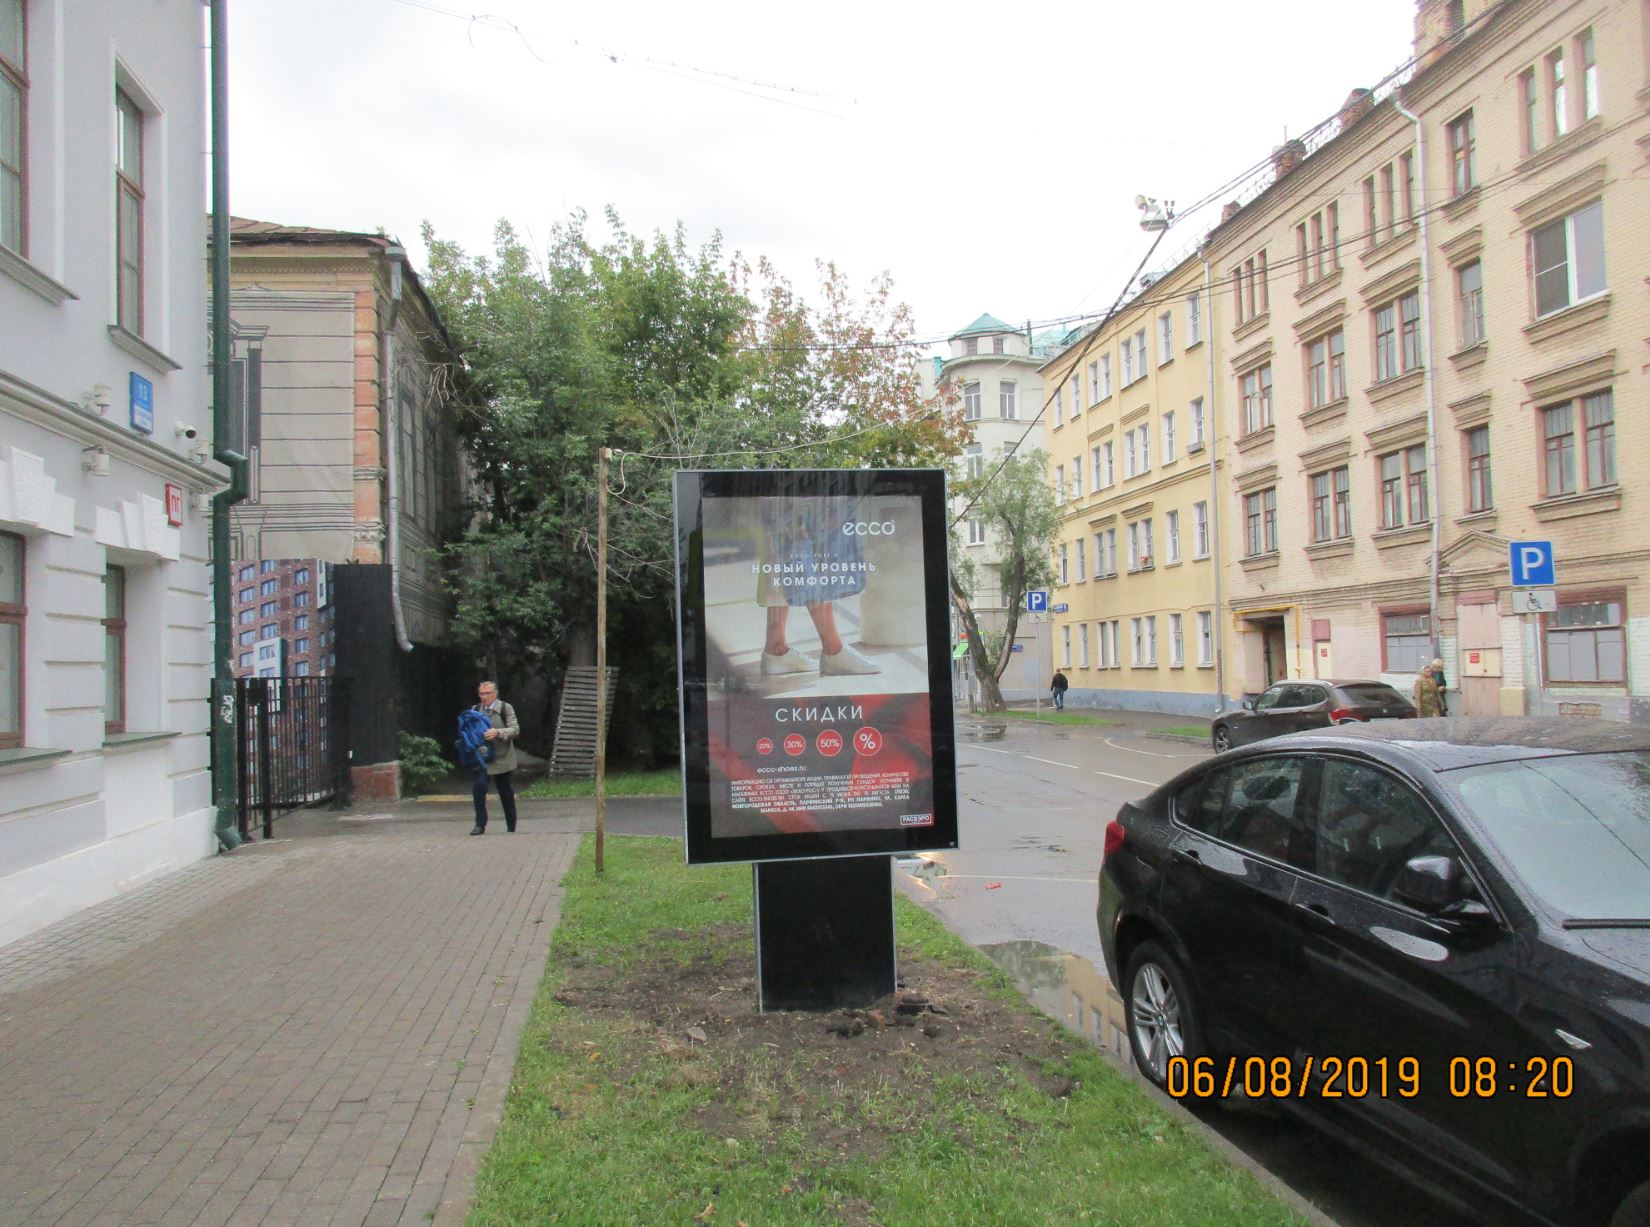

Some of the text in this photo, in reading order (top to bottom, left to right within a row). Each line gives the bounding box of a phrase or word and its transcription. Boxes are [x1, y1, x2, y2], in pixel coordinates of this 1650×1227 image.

[842, 521, 895, 536] ecco
[751, 561, 877, 574] НОВЫЙ УРОВЕНЬ
[1520, 547, 1544, 580] P
[773, 576, 856, 588] КОМФОРТА
[1032, 593, 1042, 610] P
[775, 705, 863, 723] СКИДКИ
[786, 739, 803, 749] 30%
[820, 738, 840, 749] 50%
